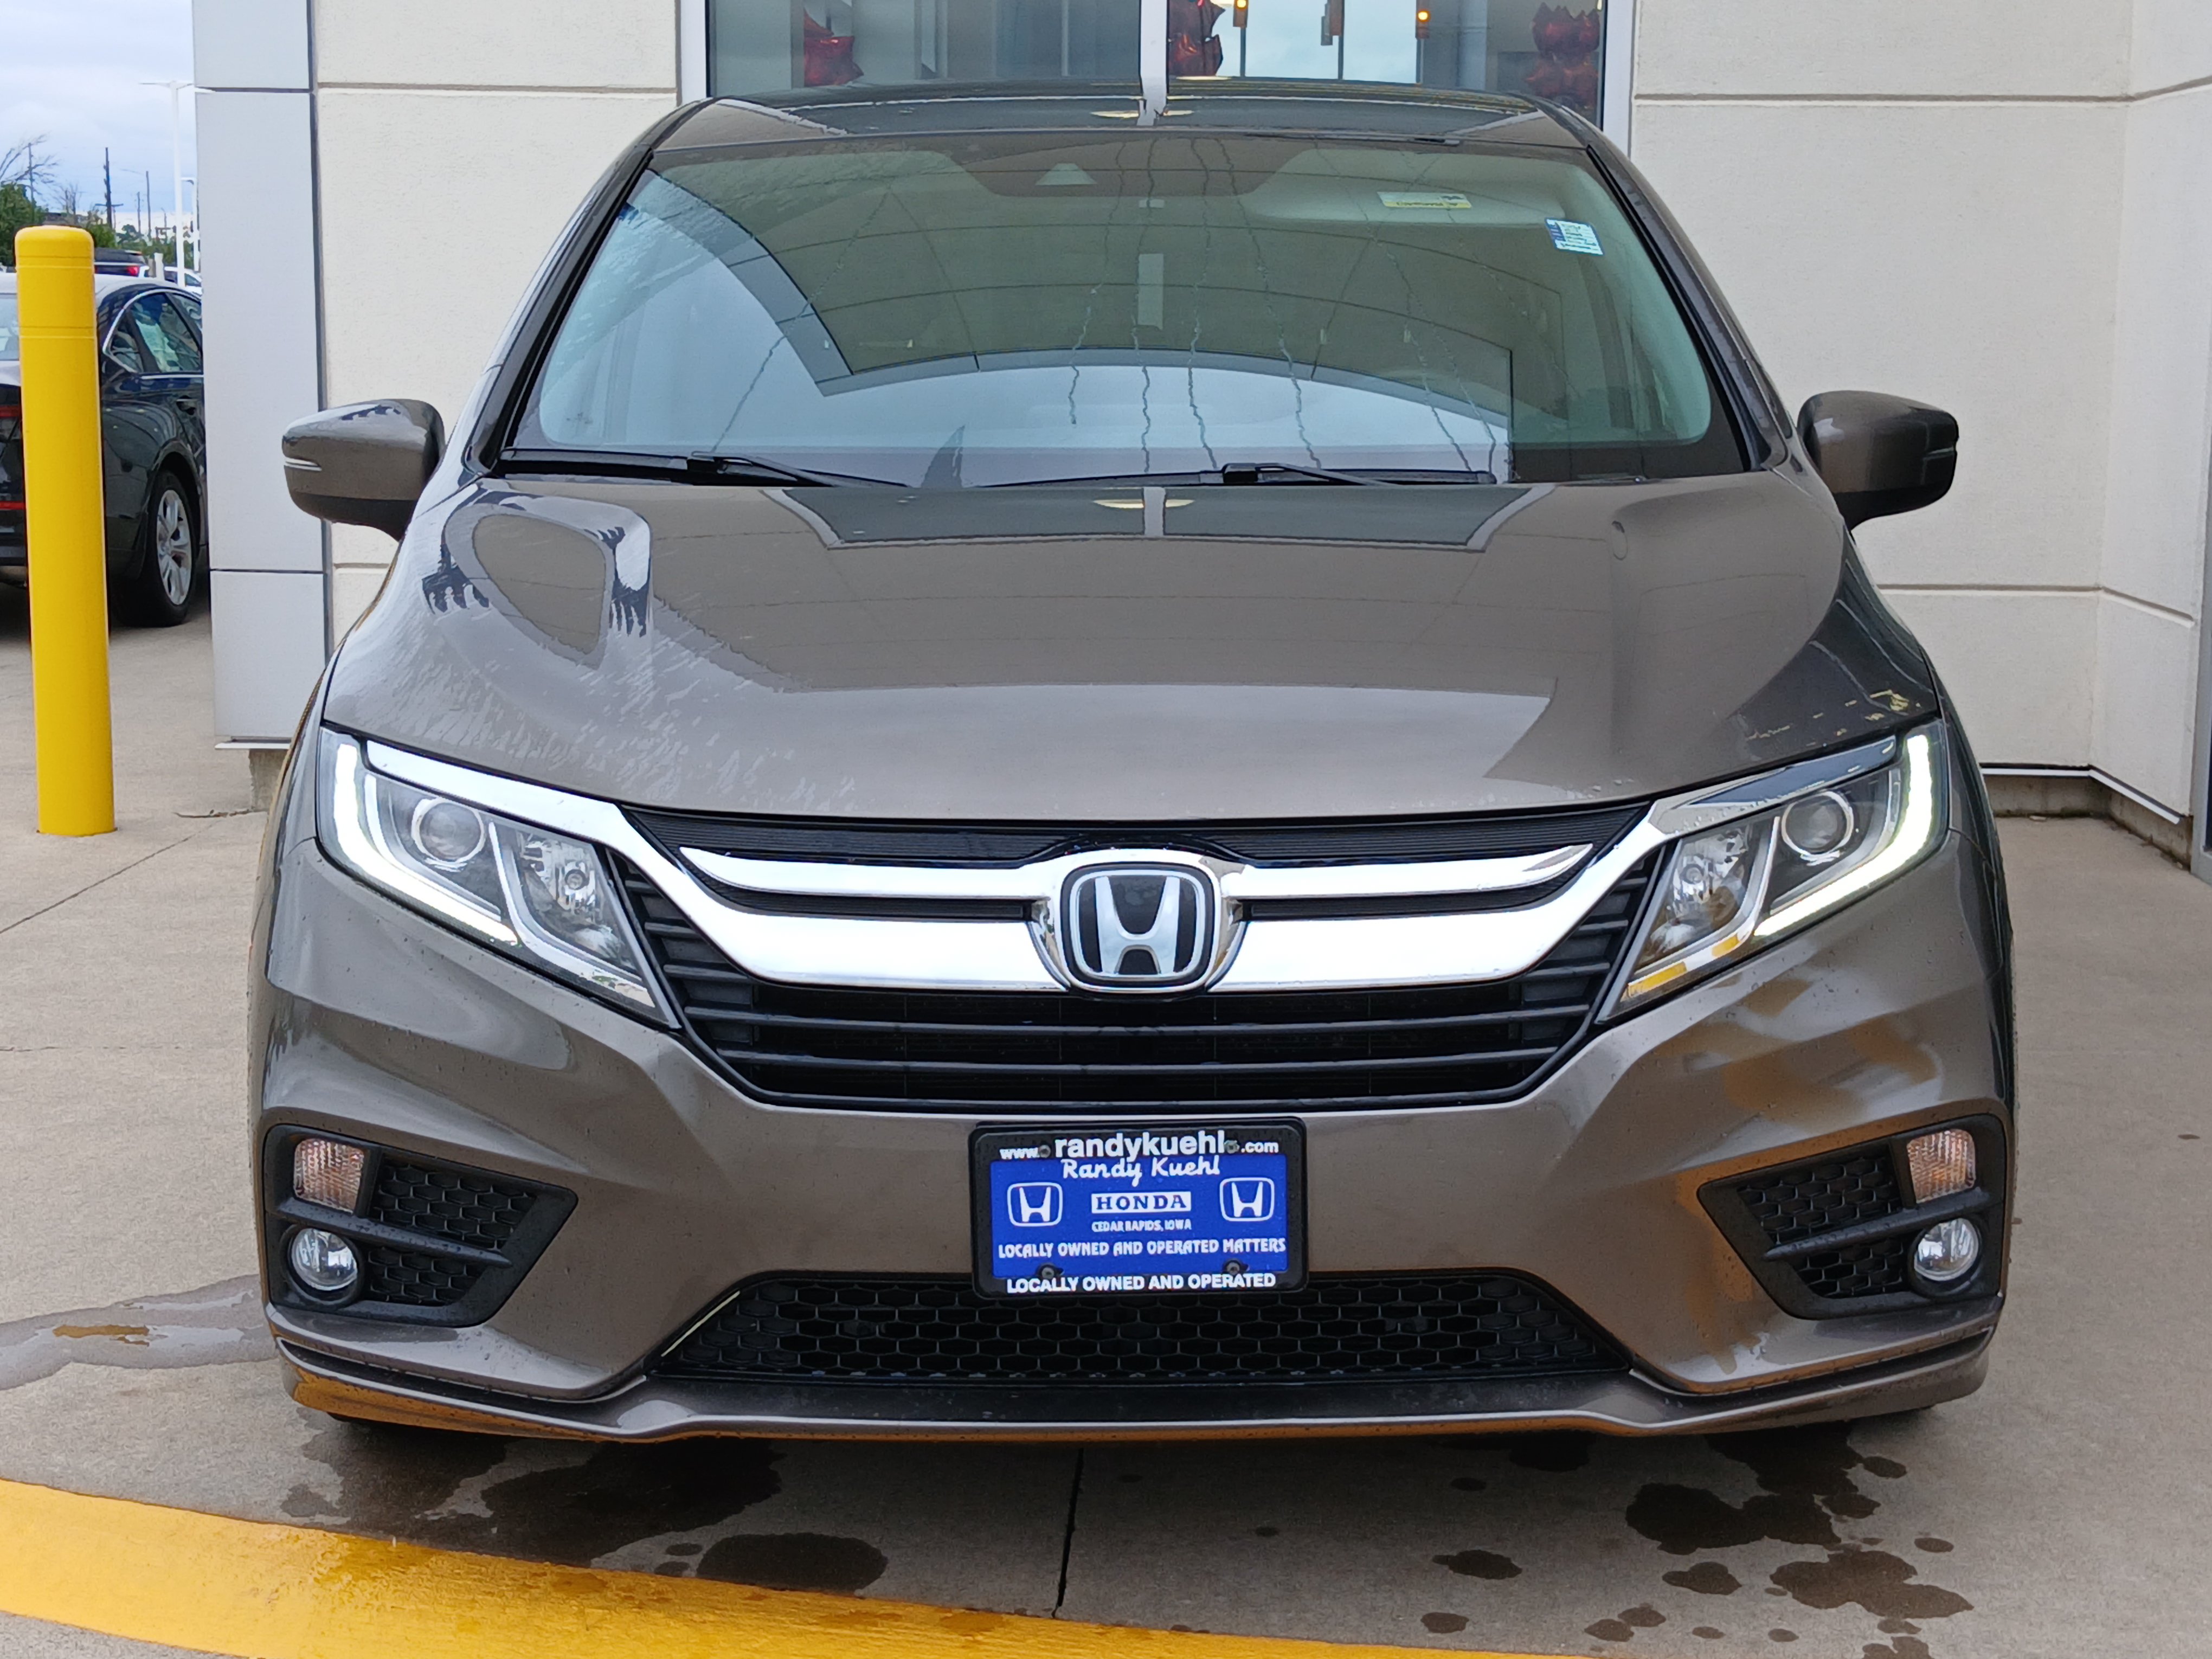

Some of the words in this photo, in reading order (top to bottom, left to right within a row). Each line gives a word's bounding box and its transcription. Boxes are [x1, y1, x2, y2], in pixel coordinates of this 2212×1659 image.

[1054, 1129, 1225, 1162] randykuehl
[1240, 1142, 1279, 1153] .com
[1060, 1158, 1142, 1187] Randy
[1151, 1154, 1220, 1177] Kuehl
[1096, 1194, 1187, 1211] HONDA
[1091, 1220, 1124, 1232] CEDAR
[1125, 1220, 1164, 1232] RAPIDS,
[1165, 1219, 1192, 1231] IOWA
[998, 1242, 1054, 1258] LOCALLY
[1058, 1242, 1110, 1257] OWNED
[1113, 1241, 1143, 1257] AND
[1147, 1239, 1219, 1255] OPERATED
[1223, 1237, 1287, 1253] MATTERS
[1007, 1277, 1079, 1294] LOCALLY
[1082, 1275, 1145, 1291] OWNED
[1148, 1275, 1184, 1290] AND
[1188, 1272, 1276, 1289] OPERATED
